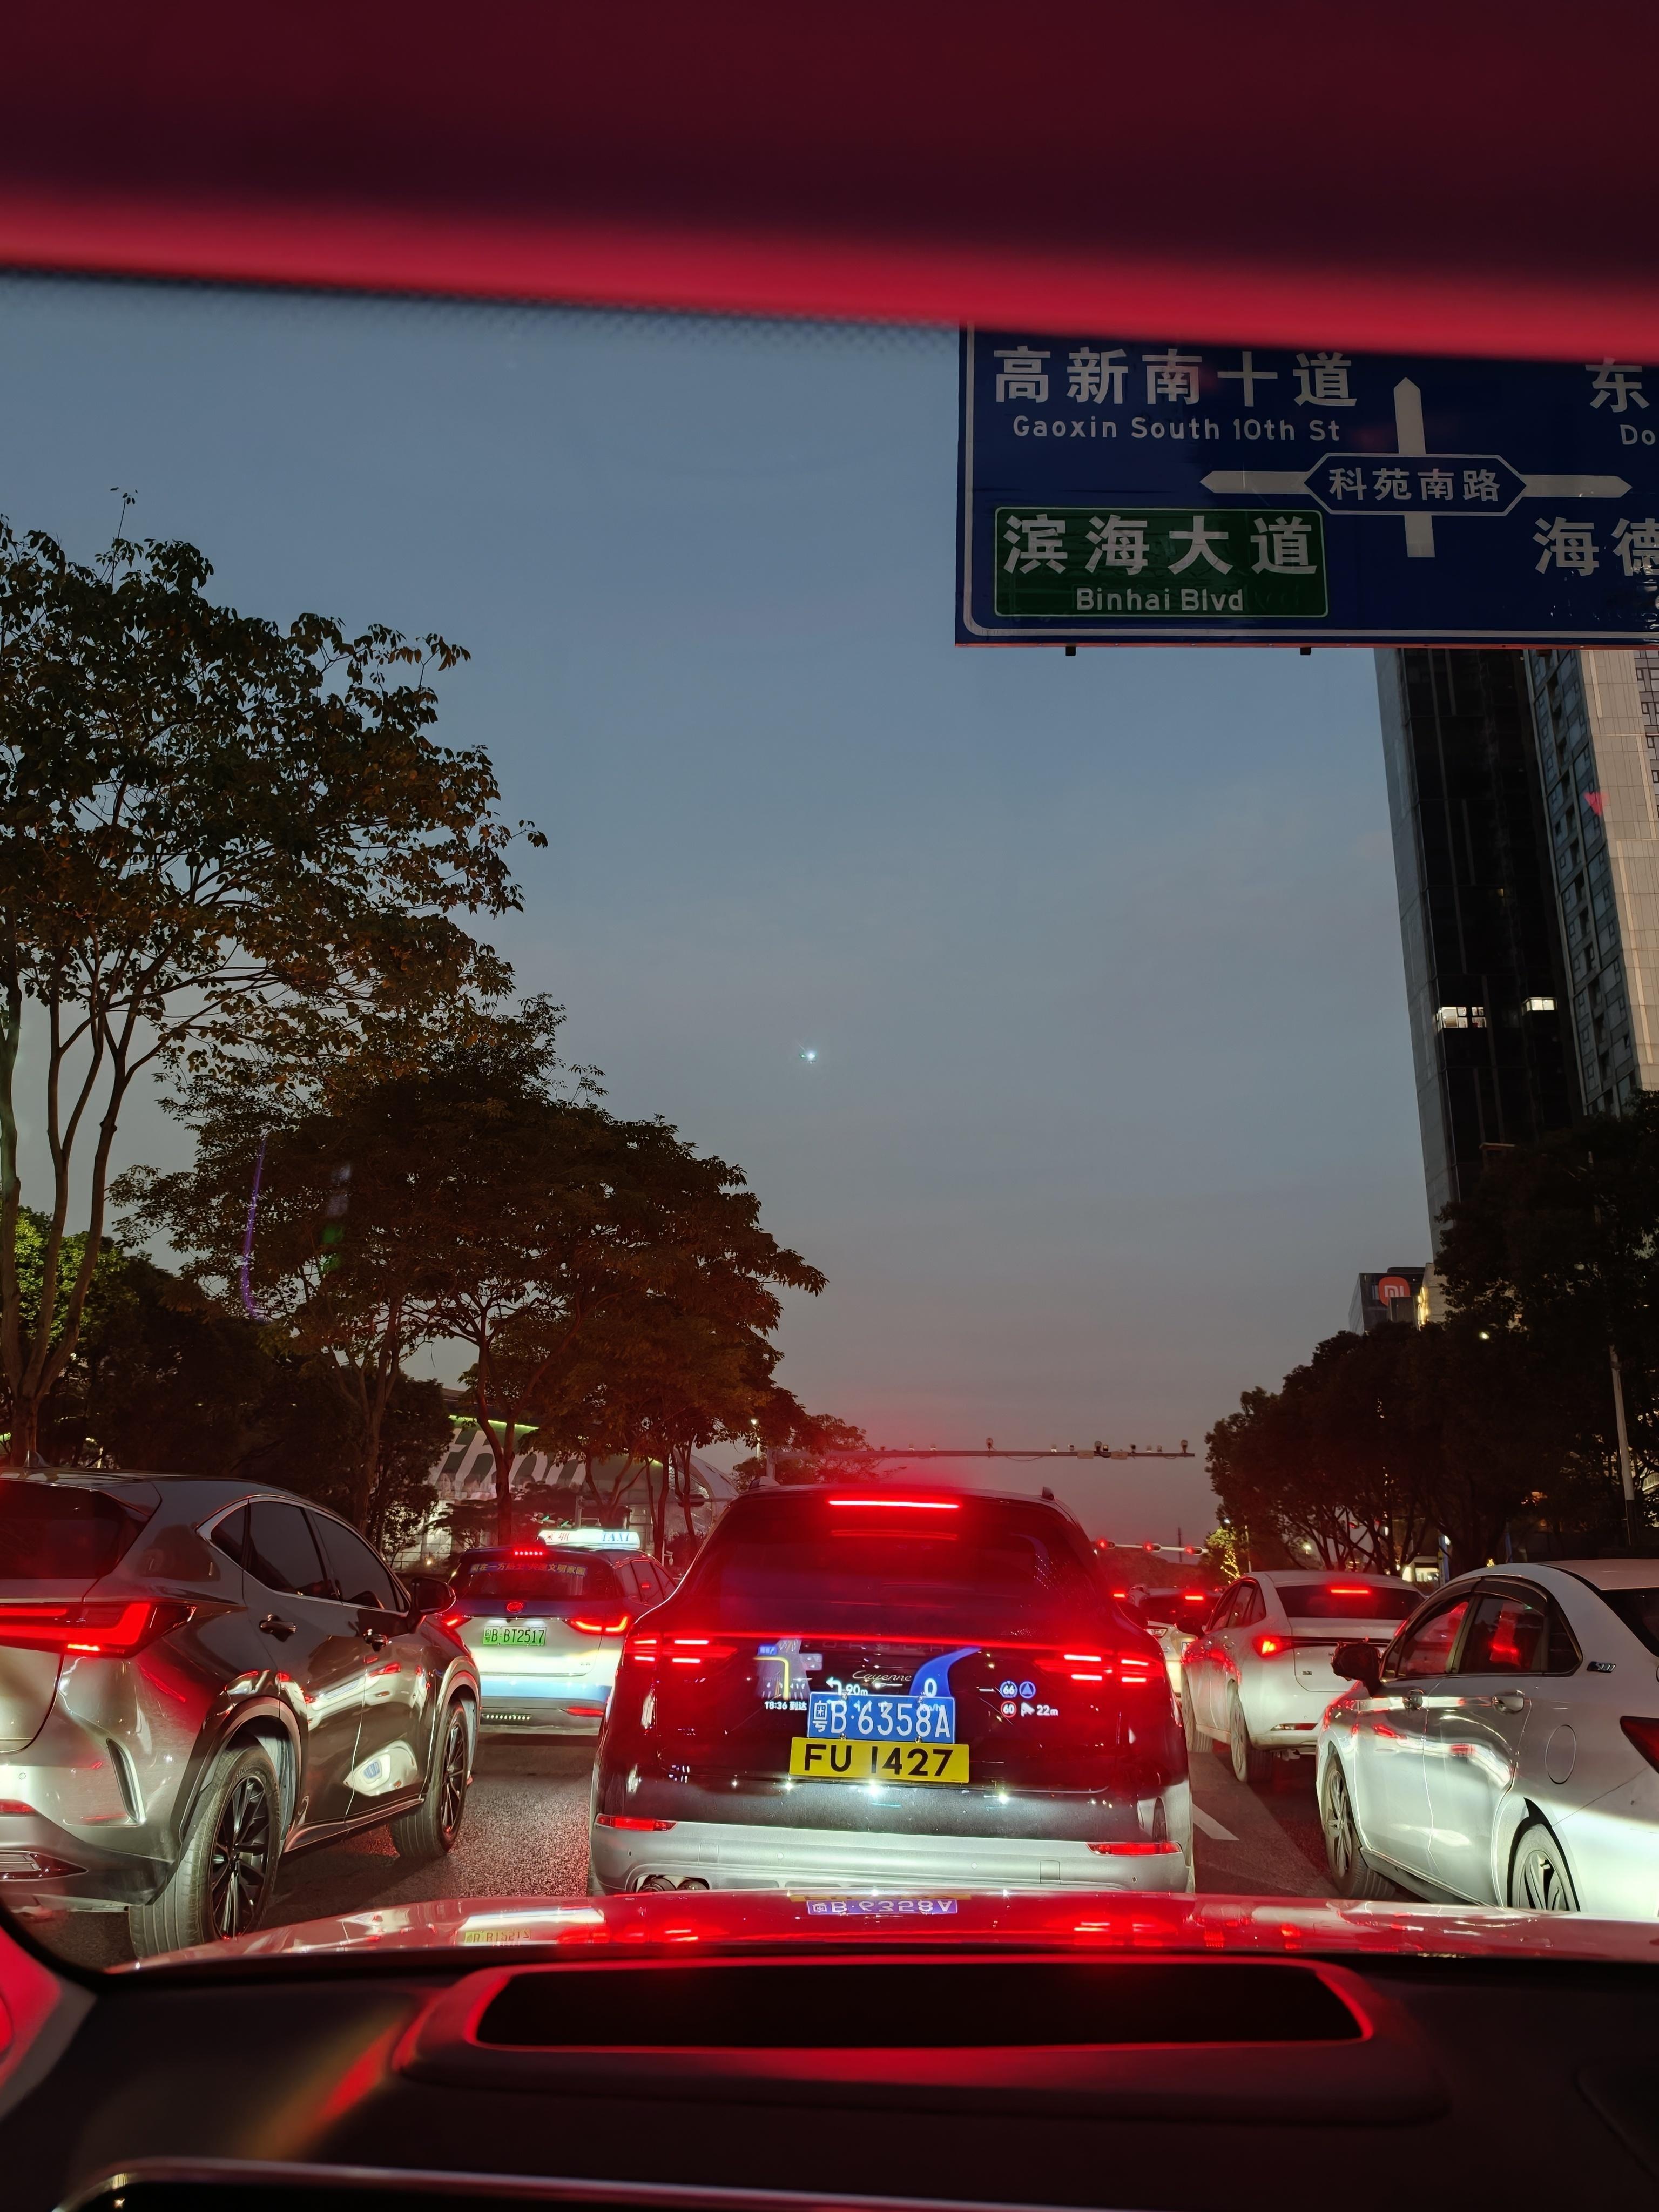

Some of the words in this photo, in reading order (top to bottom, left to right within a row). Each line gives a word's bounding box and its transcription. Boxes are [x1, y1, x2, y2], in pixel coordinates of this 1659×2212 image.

[993, 346, 1357, 407] 高新南十道
[1584, 357, 1650, 413] 东
[1013, 415, 1117, 437] Gaoxin
[1131, 416, 1219, 439] South
[1235, 419, 1294, 440] 10th
[1310, 420, 1340, 441] St
[1328, 468, 1501, 501] 科苑南路
[1003, 514, 1317, 575] 滨海大道
[1076, 588, 1170, 611] Binhai
[1181, 589, 1244, 611] Blvd
[602, 1533, 630, 1542] TAXI
[852, 1670, 912, 1685] Cayenne
[764, 1701, 788, 1710] 18:36
[789, 1701, 807, 1711] 到达
[1036, 1704, 1059, 1716] 22m
[804, 1743, 852, 1772] FU
[871, 1746, 954, 1777] 1427
